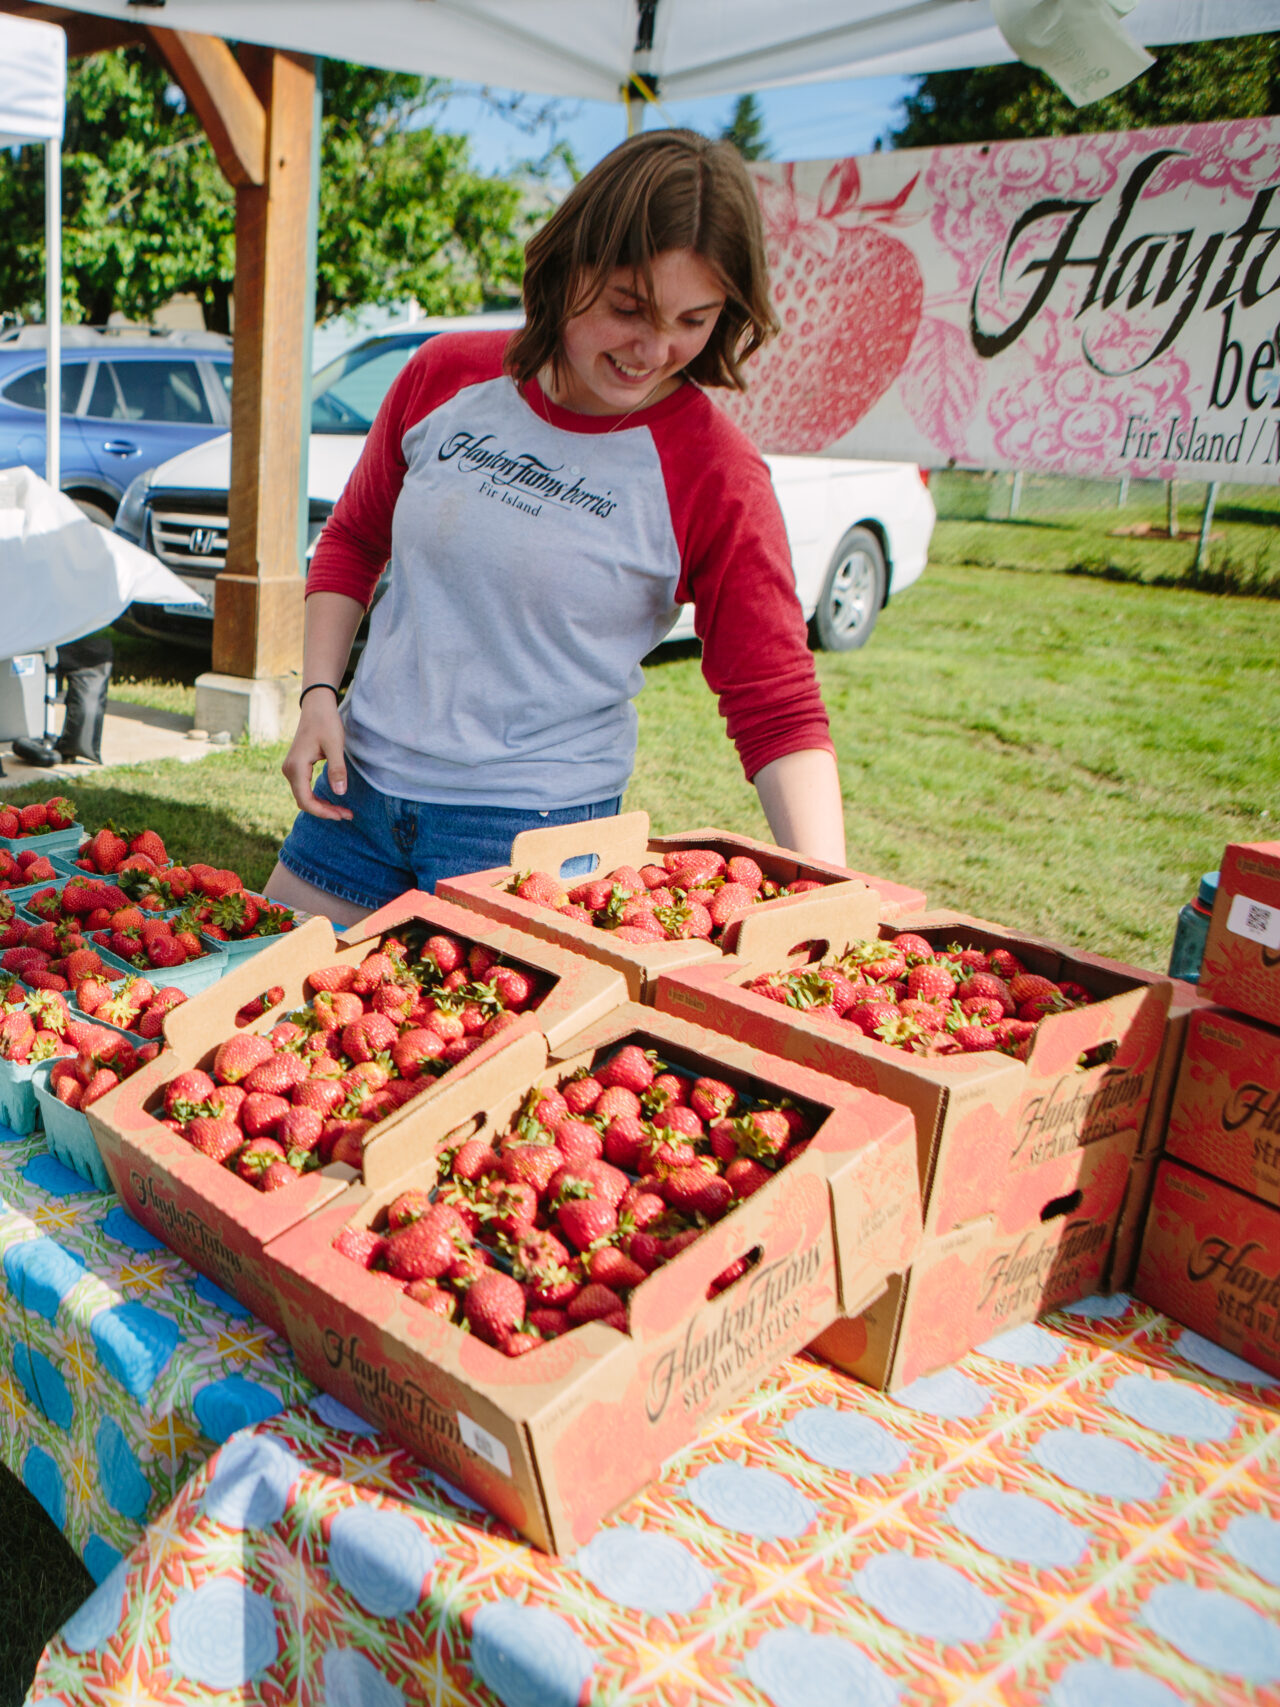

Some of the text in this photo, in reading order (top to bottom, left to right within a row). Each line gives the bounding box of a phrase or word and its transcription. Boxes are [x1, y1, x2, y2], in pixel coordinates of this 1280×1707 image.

[1207, 299, 1280, 412] be
[438, 431, 617, 519] Hayton Farms berries
[1119, 414, 1159, 459] Fir
[1161, 415, 1249, 464] Island
[478, 481, 543, 518] Fir Island
[322, 1328, 477, 1458] Hayton Farm
[645, 1299, 760, 1424] Hayton
